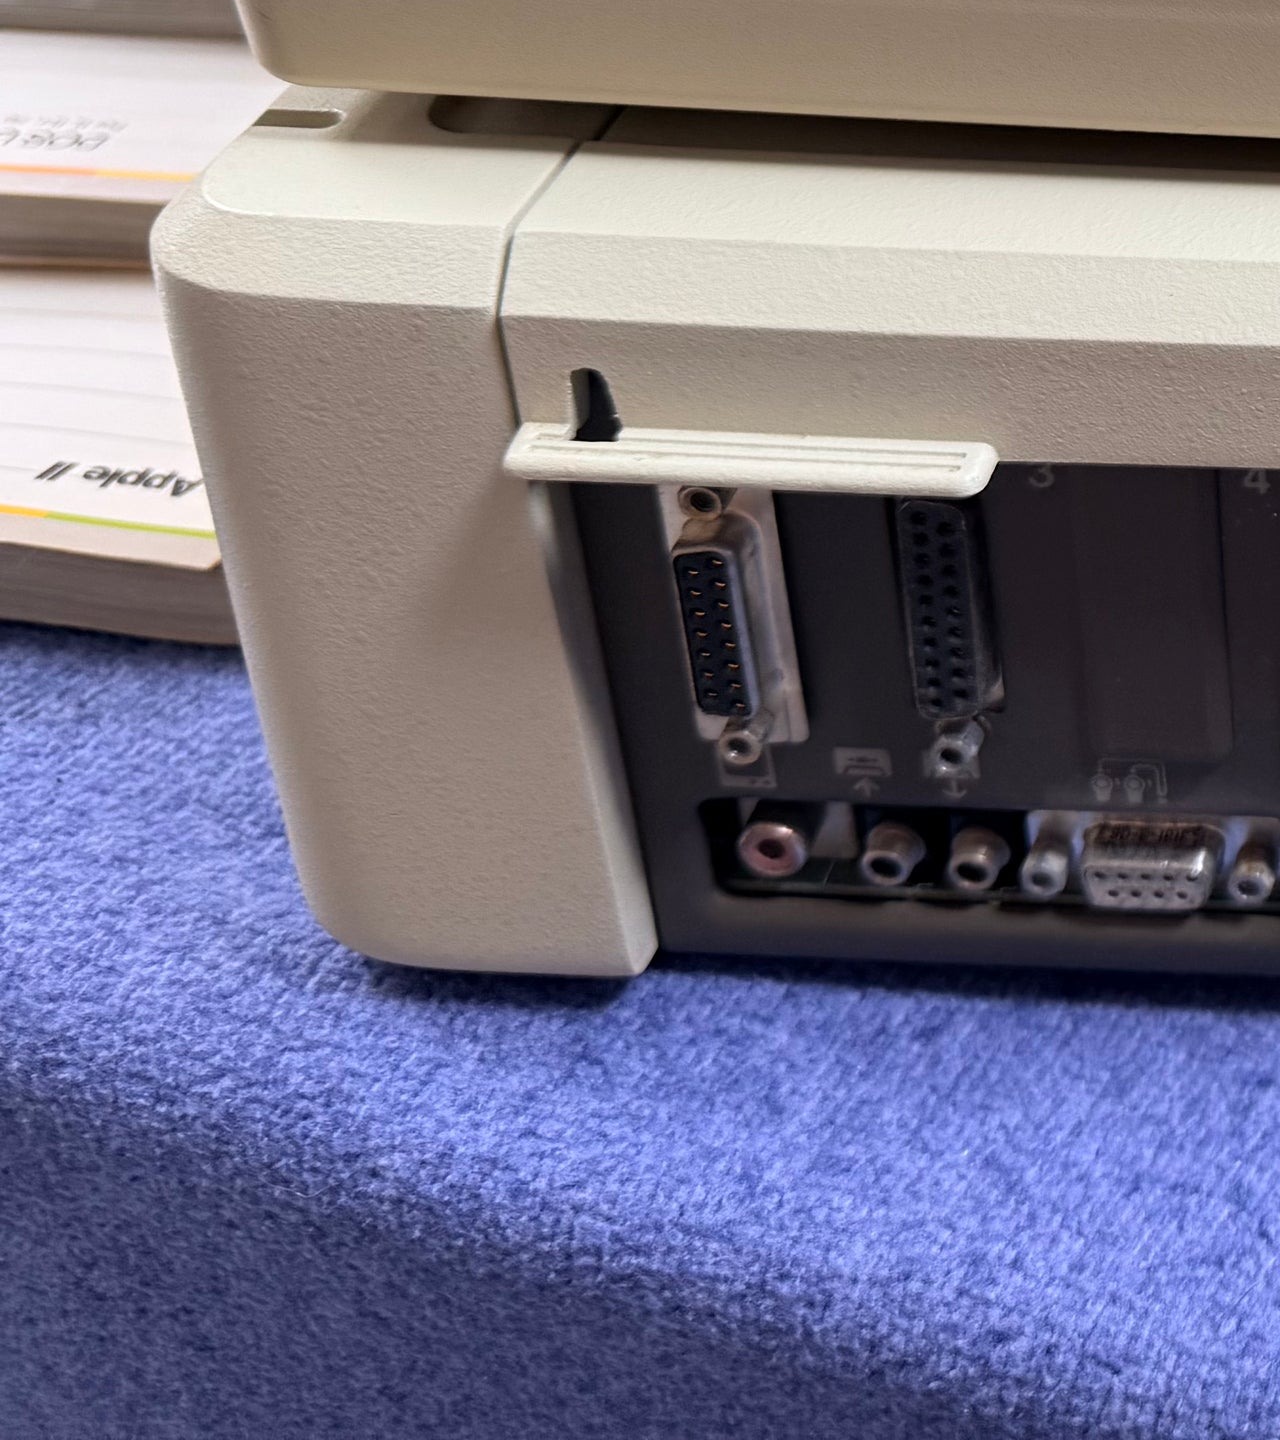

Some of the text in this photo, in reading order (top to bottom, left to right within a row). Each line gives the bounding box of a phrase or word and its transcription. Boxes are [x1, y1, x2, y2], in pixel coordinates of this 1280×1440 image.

[82, 464, 204, 497] Apple
[1028, 464, 1055, 489] 3
[1243, 468, 1271, 495] 4
